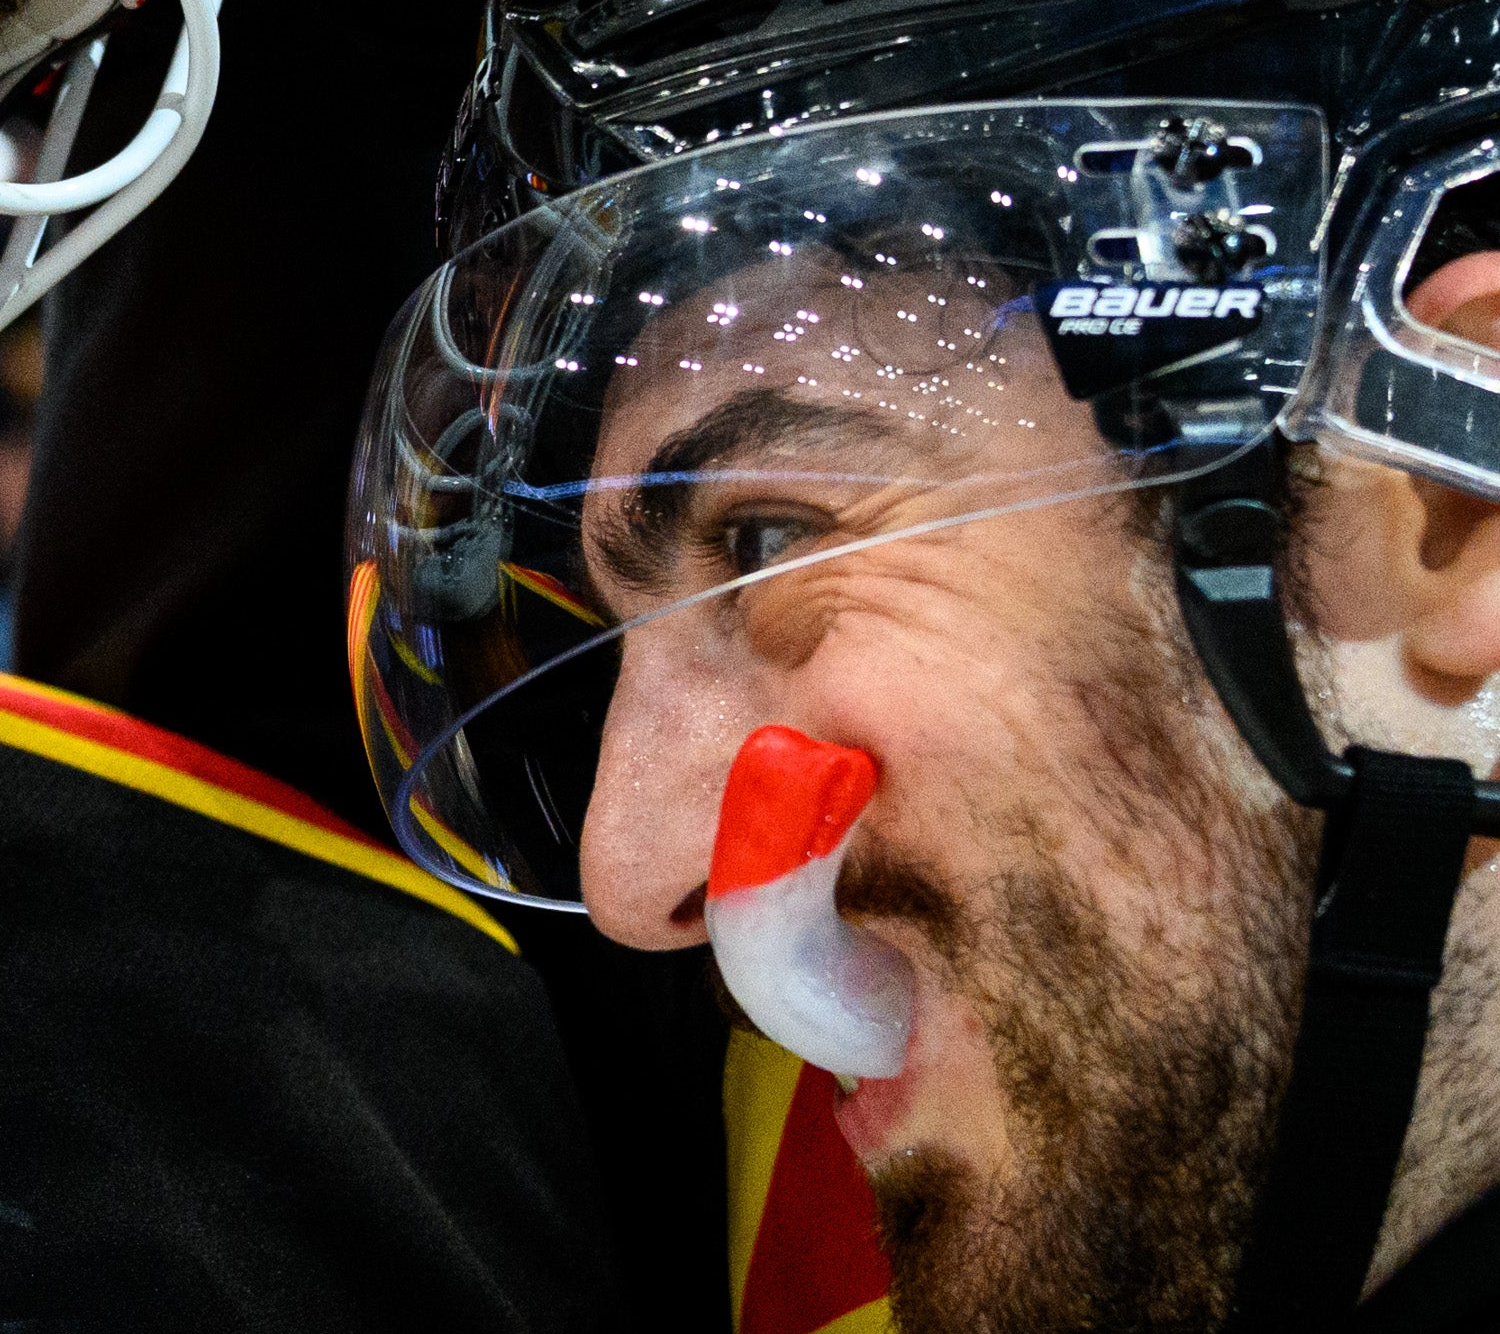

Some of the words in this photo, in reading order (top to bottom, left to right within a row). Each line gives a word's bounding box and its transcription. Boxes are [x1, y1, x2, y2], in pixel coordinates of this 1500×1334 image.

[1050, 287, 1262, 318] BAUER
[1058, 318, 1110, 335] PRO
[1109, 318, 1143, 335] CE
